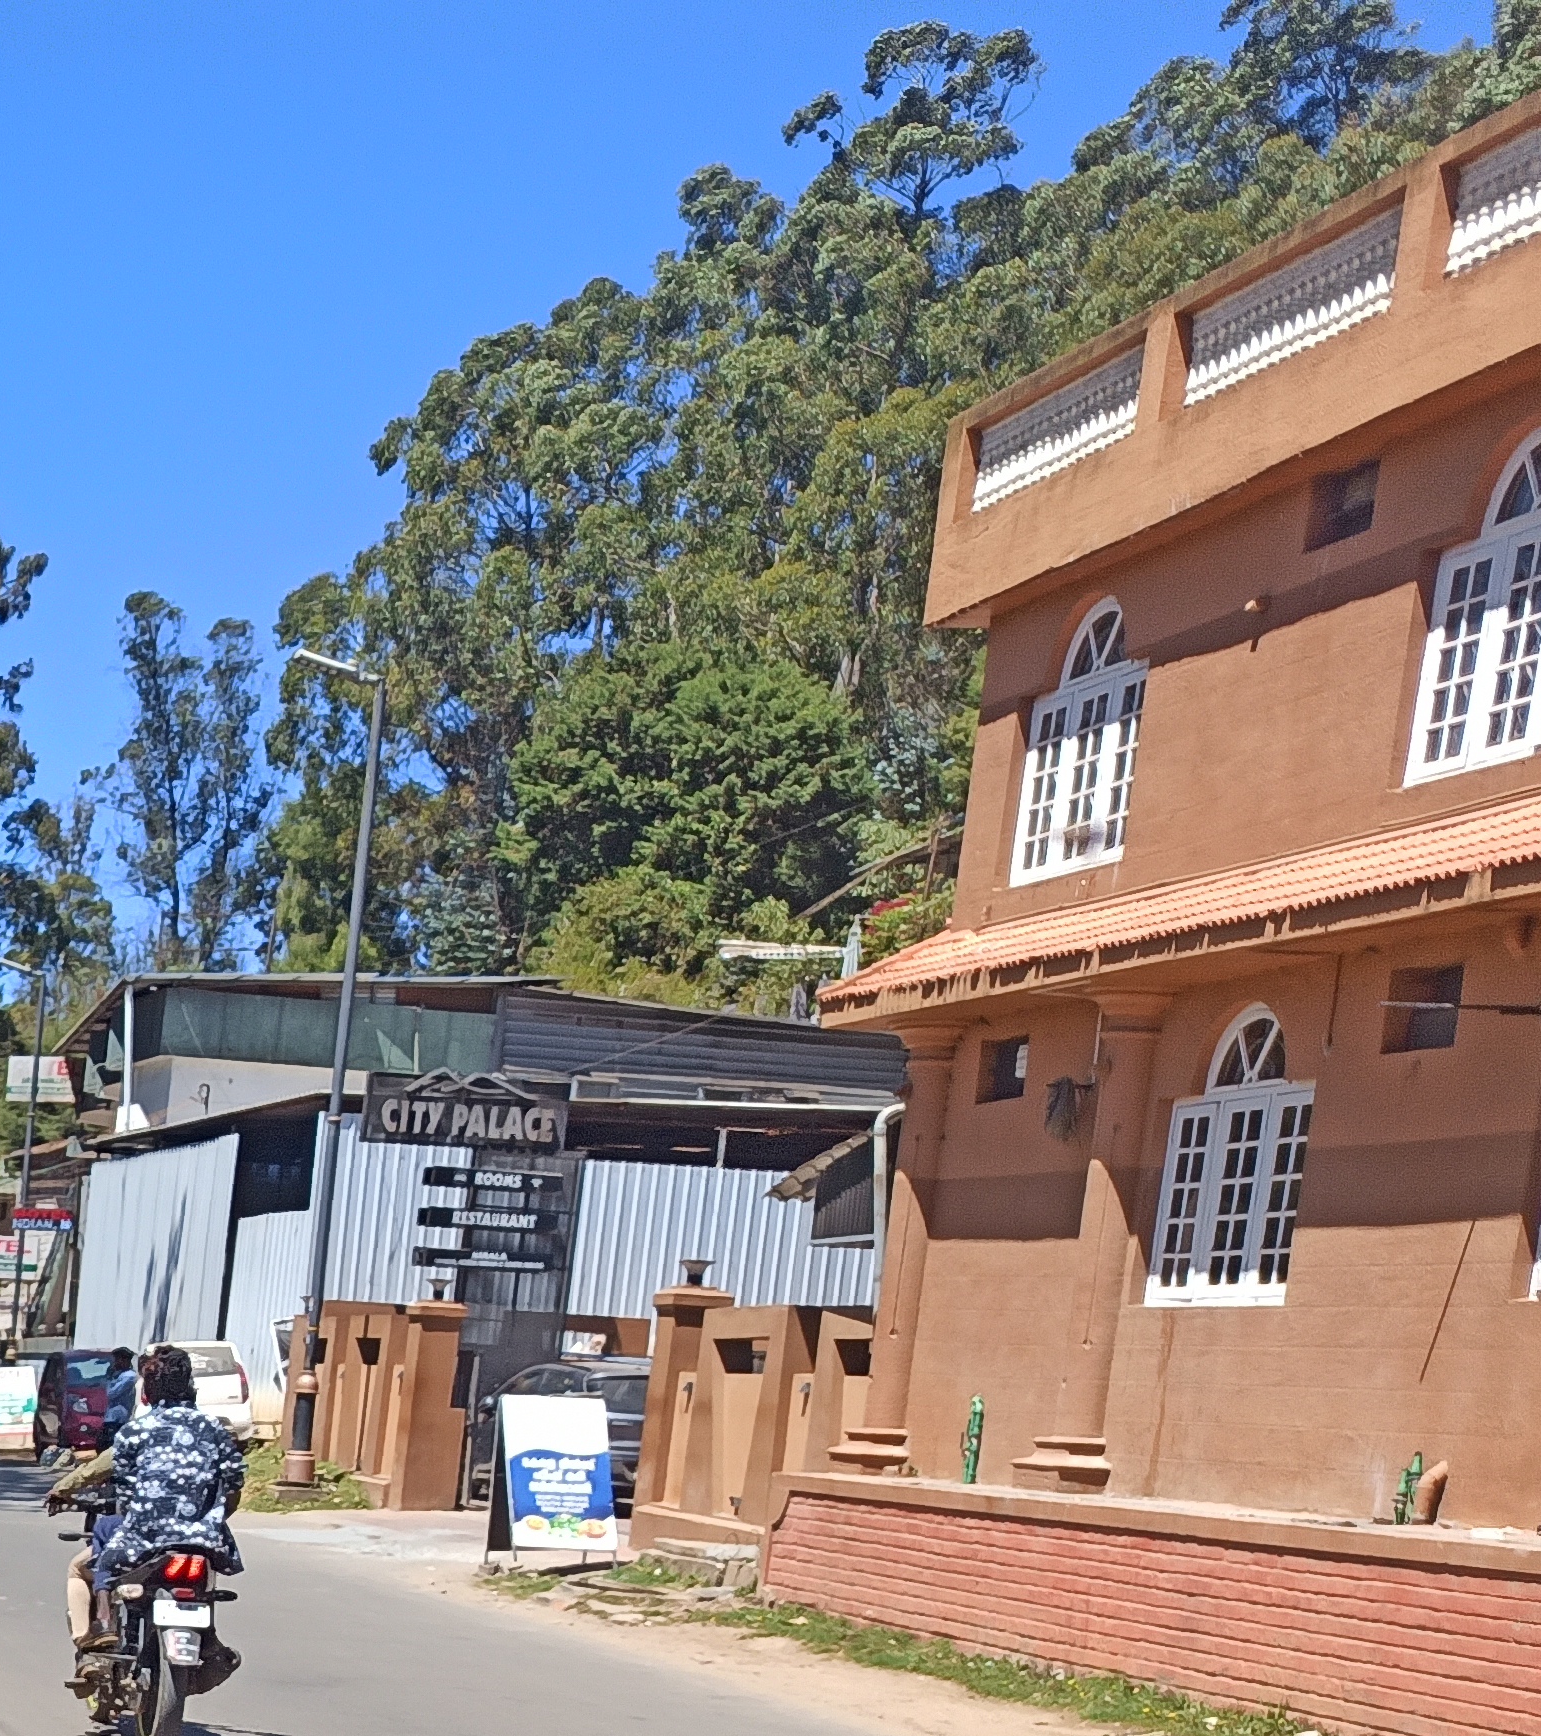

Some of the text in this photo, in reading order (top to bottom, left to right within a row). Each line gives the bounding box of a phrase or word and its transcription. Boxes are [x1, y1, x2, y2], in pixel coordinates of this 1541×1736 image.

[381, 1098, 556, 1143] CITY PALACE
[473, 1171, 523, 1188] ROOMS
[451, 1210, 538, 1229] RESTAURANT
